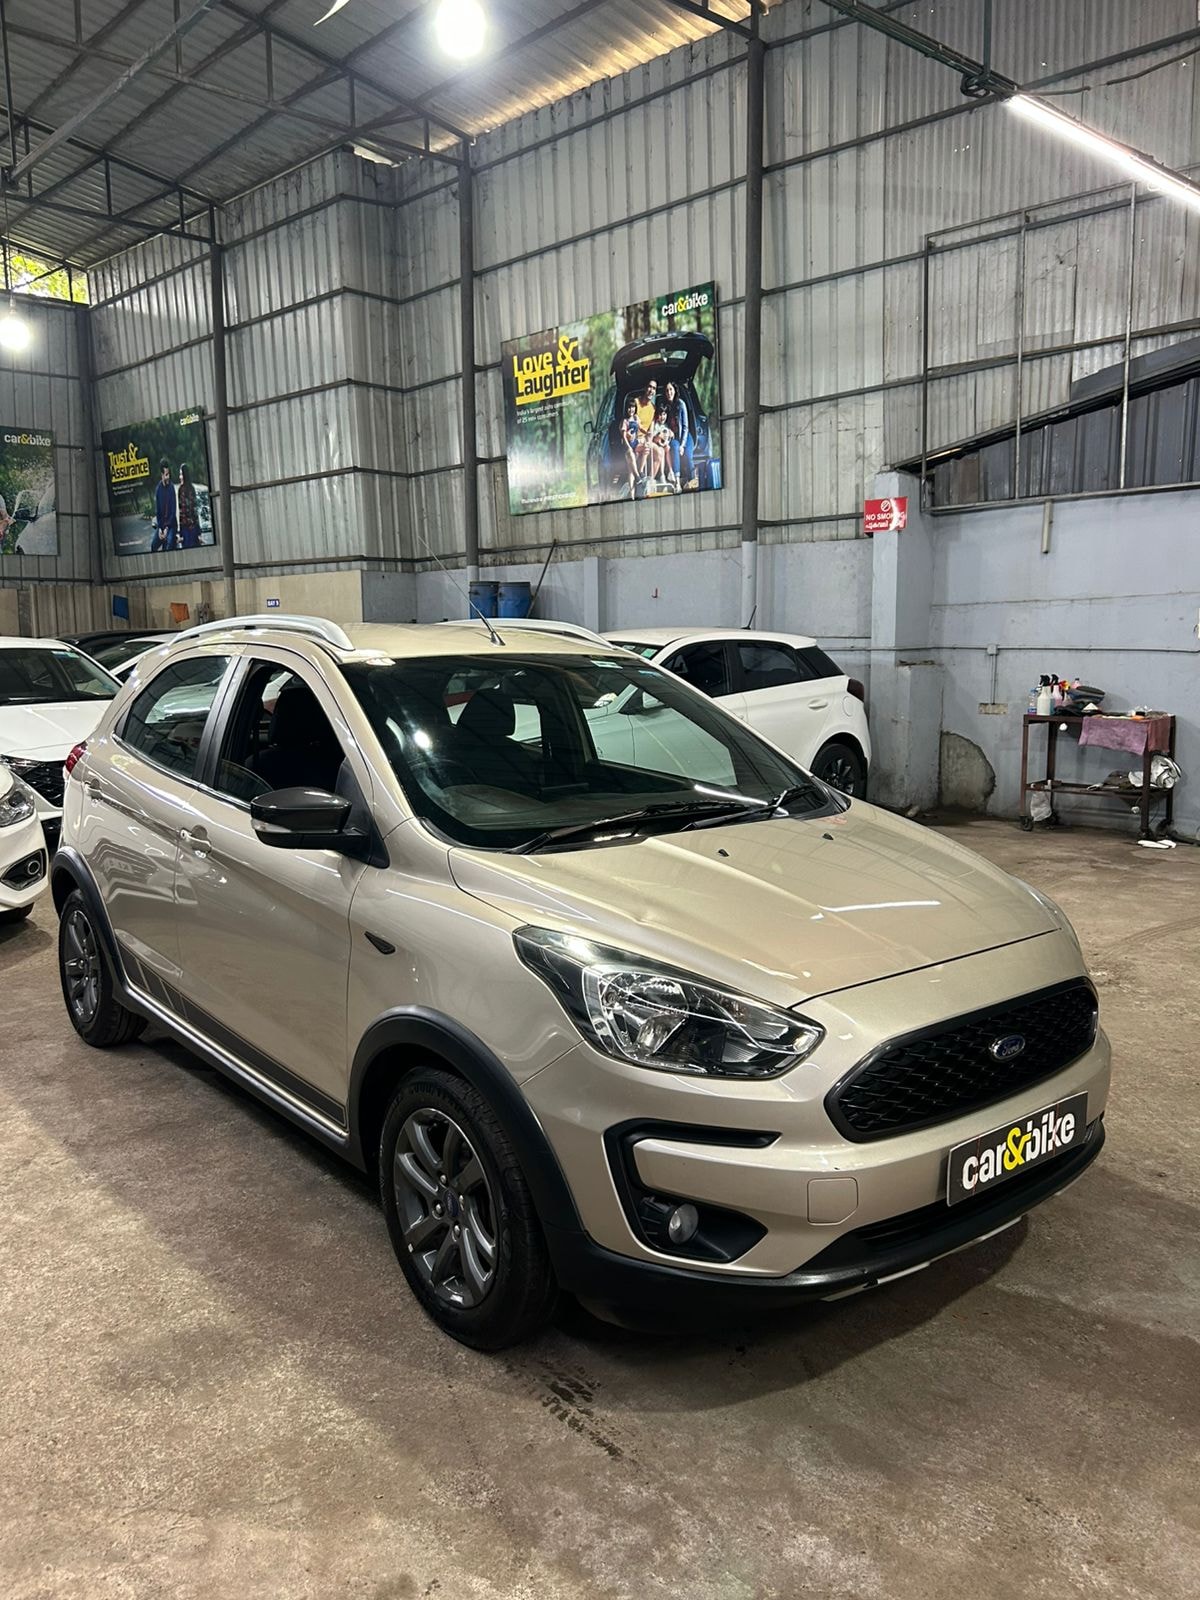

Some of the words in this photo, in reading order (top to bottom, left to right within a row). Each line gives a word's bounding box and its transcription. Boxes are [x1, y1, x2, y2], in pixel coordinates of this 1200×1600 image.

[661, 292, 708, 317] car&bike
[513, 351, 553, 377] Love
[557, 335, 578, 365] &
[515, 364, 588, 397] Laughter
[4, 433, 51, 447] car&bike
[108, 449, 127, 467] Trust
[128, 442, 138, 461] &
[110, 462, 148, 480] Assurance
[865, 513, 876, 521] NO
[962, 1111, 1075, 1190] car&bike
